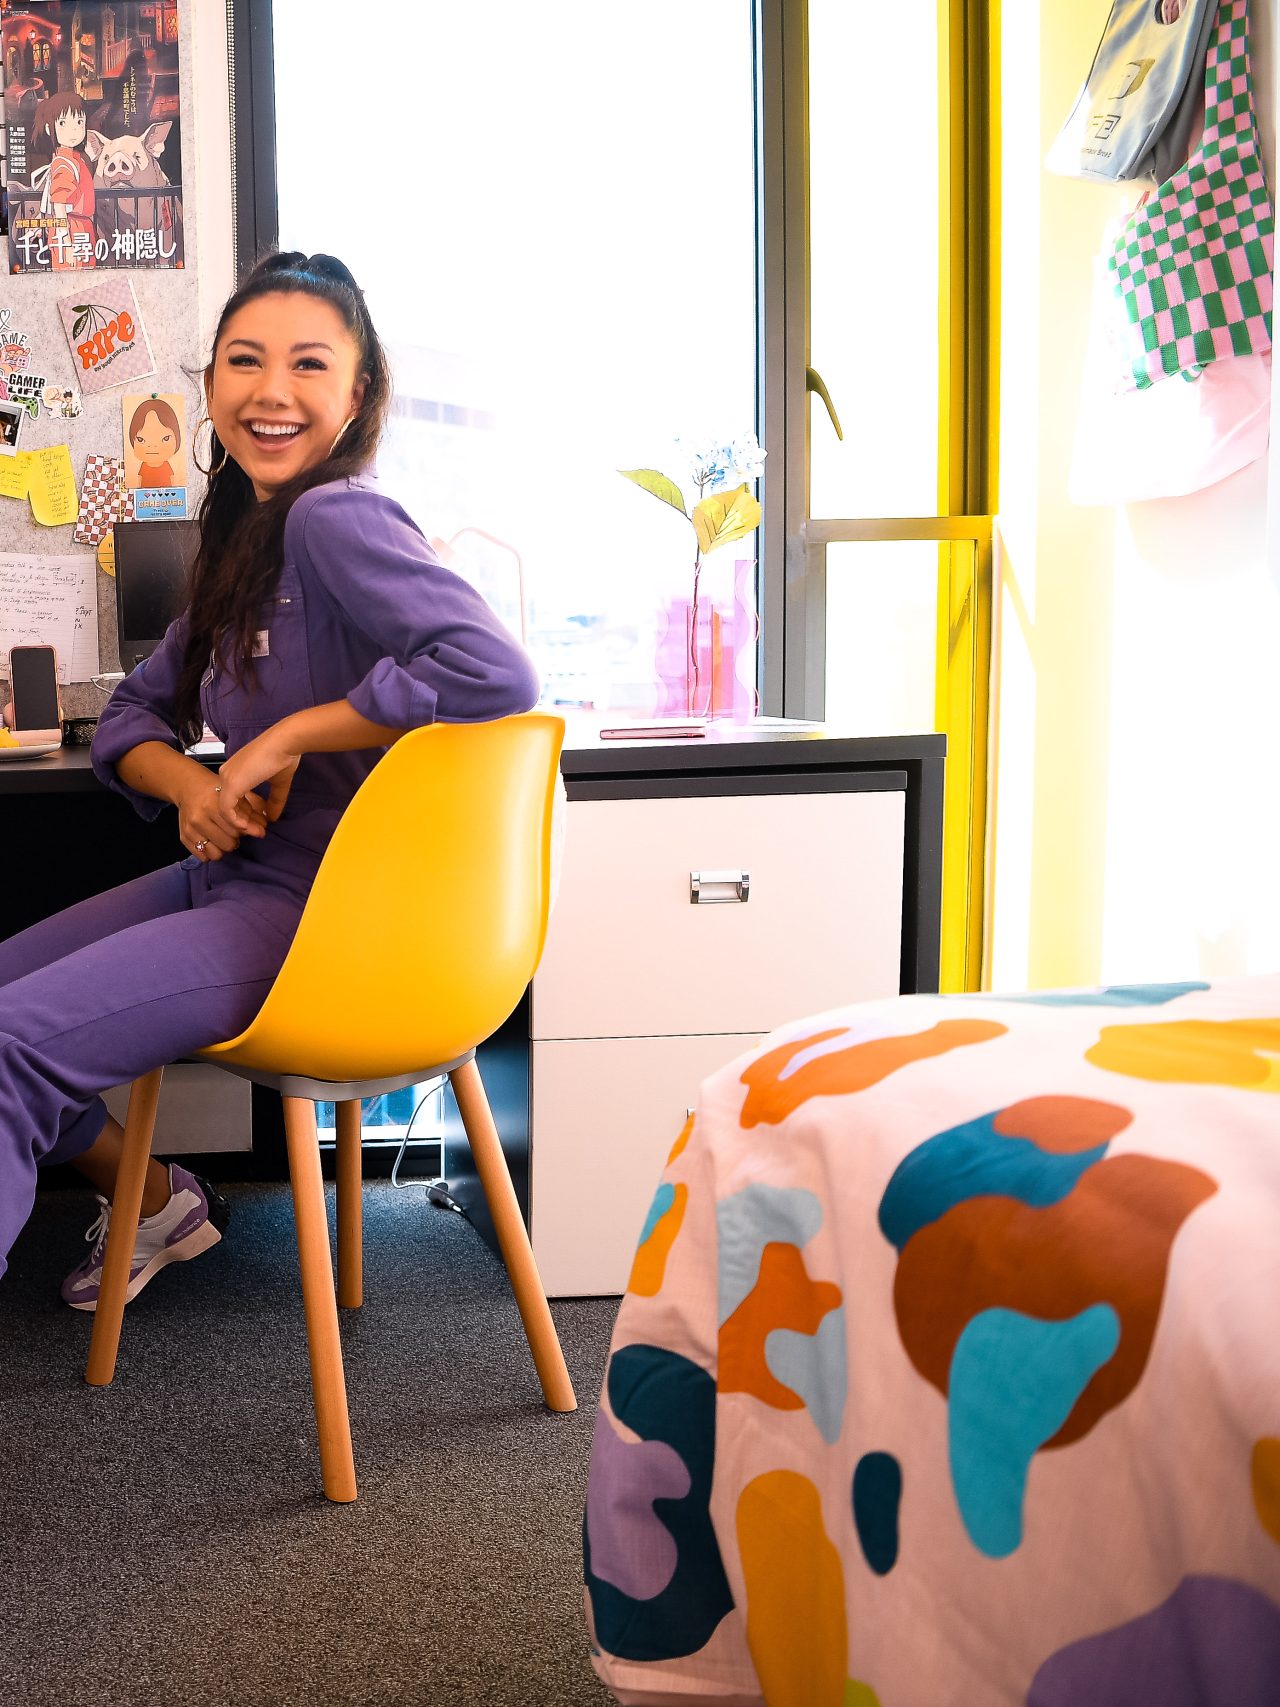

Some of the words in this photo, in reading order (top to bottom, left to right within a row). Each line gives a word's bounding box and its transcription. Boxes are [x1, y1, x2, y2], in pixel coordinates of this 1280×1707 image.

[16, 228, 177, 265] 千と千尋の神隠し
[77, 311, 135, 369] RIPE
[8, 386, 43, 398] LIFE
[9, 373, 46, 389] GAMER
